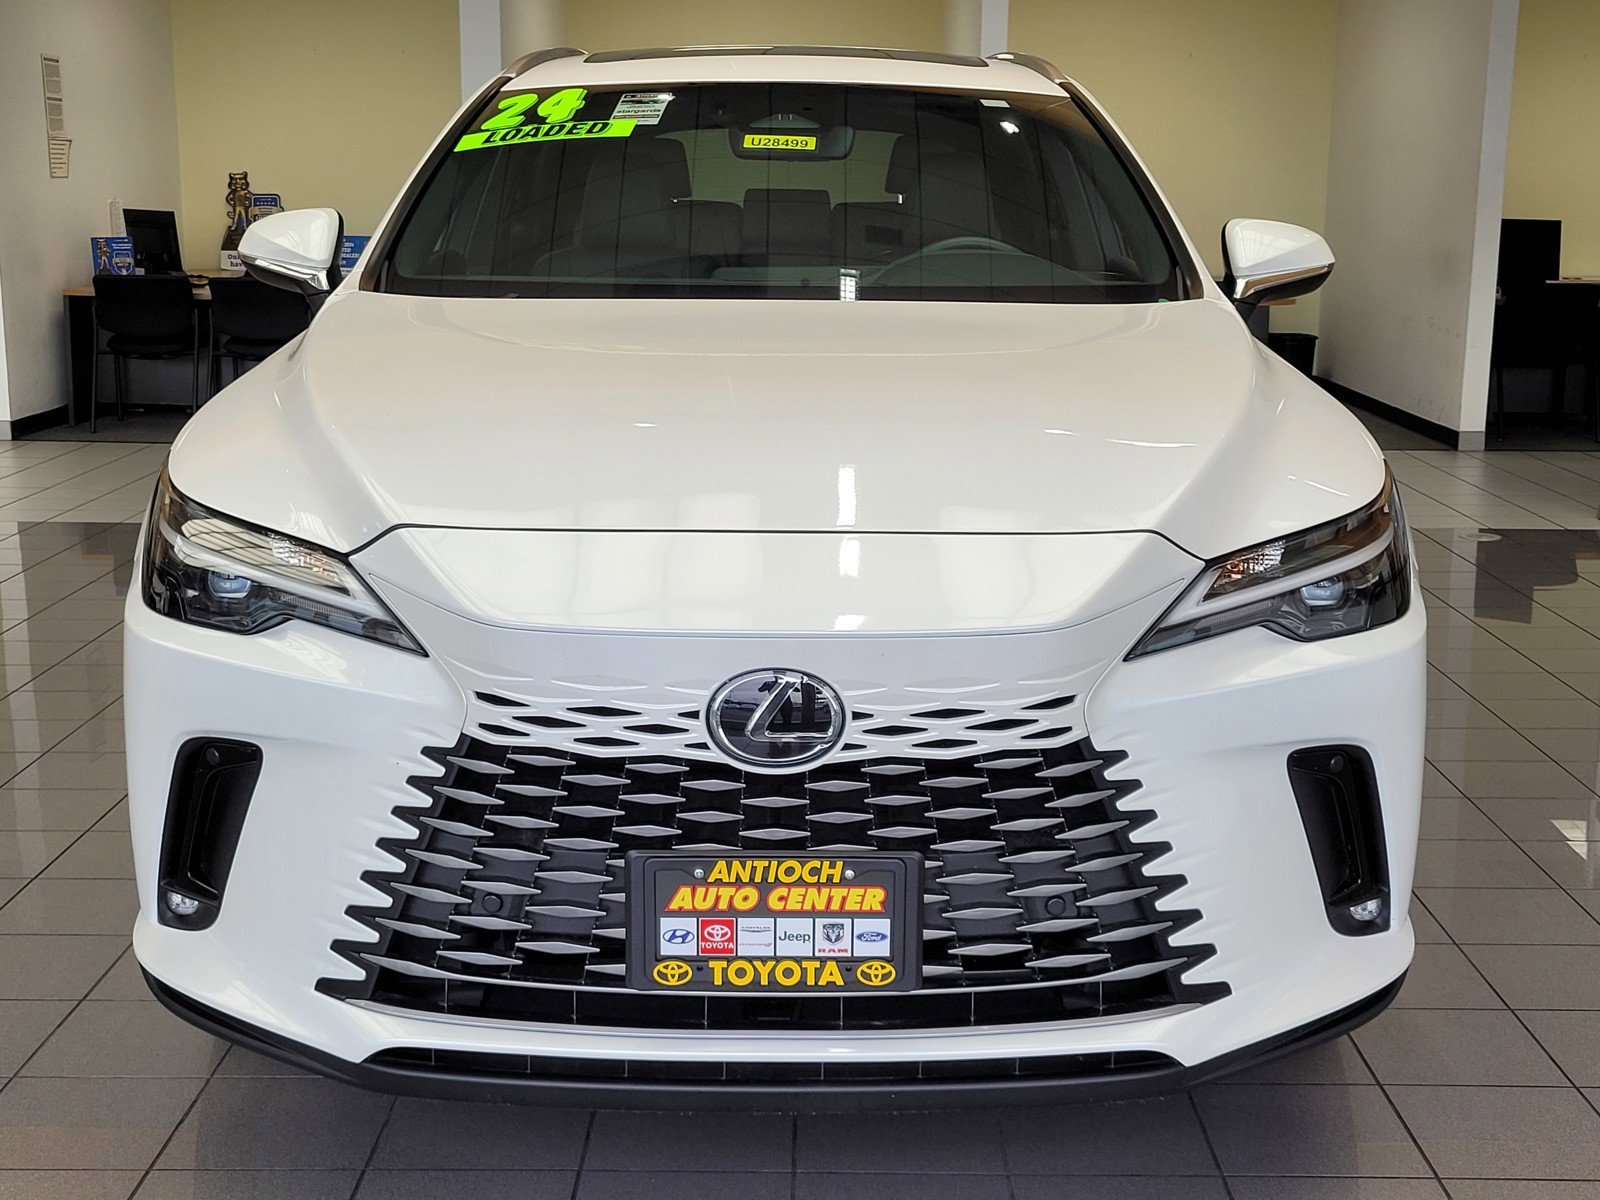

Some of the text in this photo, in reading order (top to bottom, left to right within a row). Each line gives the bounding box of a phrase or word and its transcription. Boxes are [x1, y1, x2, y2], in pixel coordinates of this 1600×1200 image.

[481, 88, 588, 131] 24
[481, 121, 613, 145] LOADED
[750, 137, 809, 149] U28499
[706, 859, 845, 884] ANTIOCH
[665, 885, 886, 912] AUTO CENTER
[700, 941, 735, 949] TOYOTA
[778, 930, 811, 944] Jeep
[861, 932, 883, 942] Ford
[708, 960, 845, 986] TOYOTA
